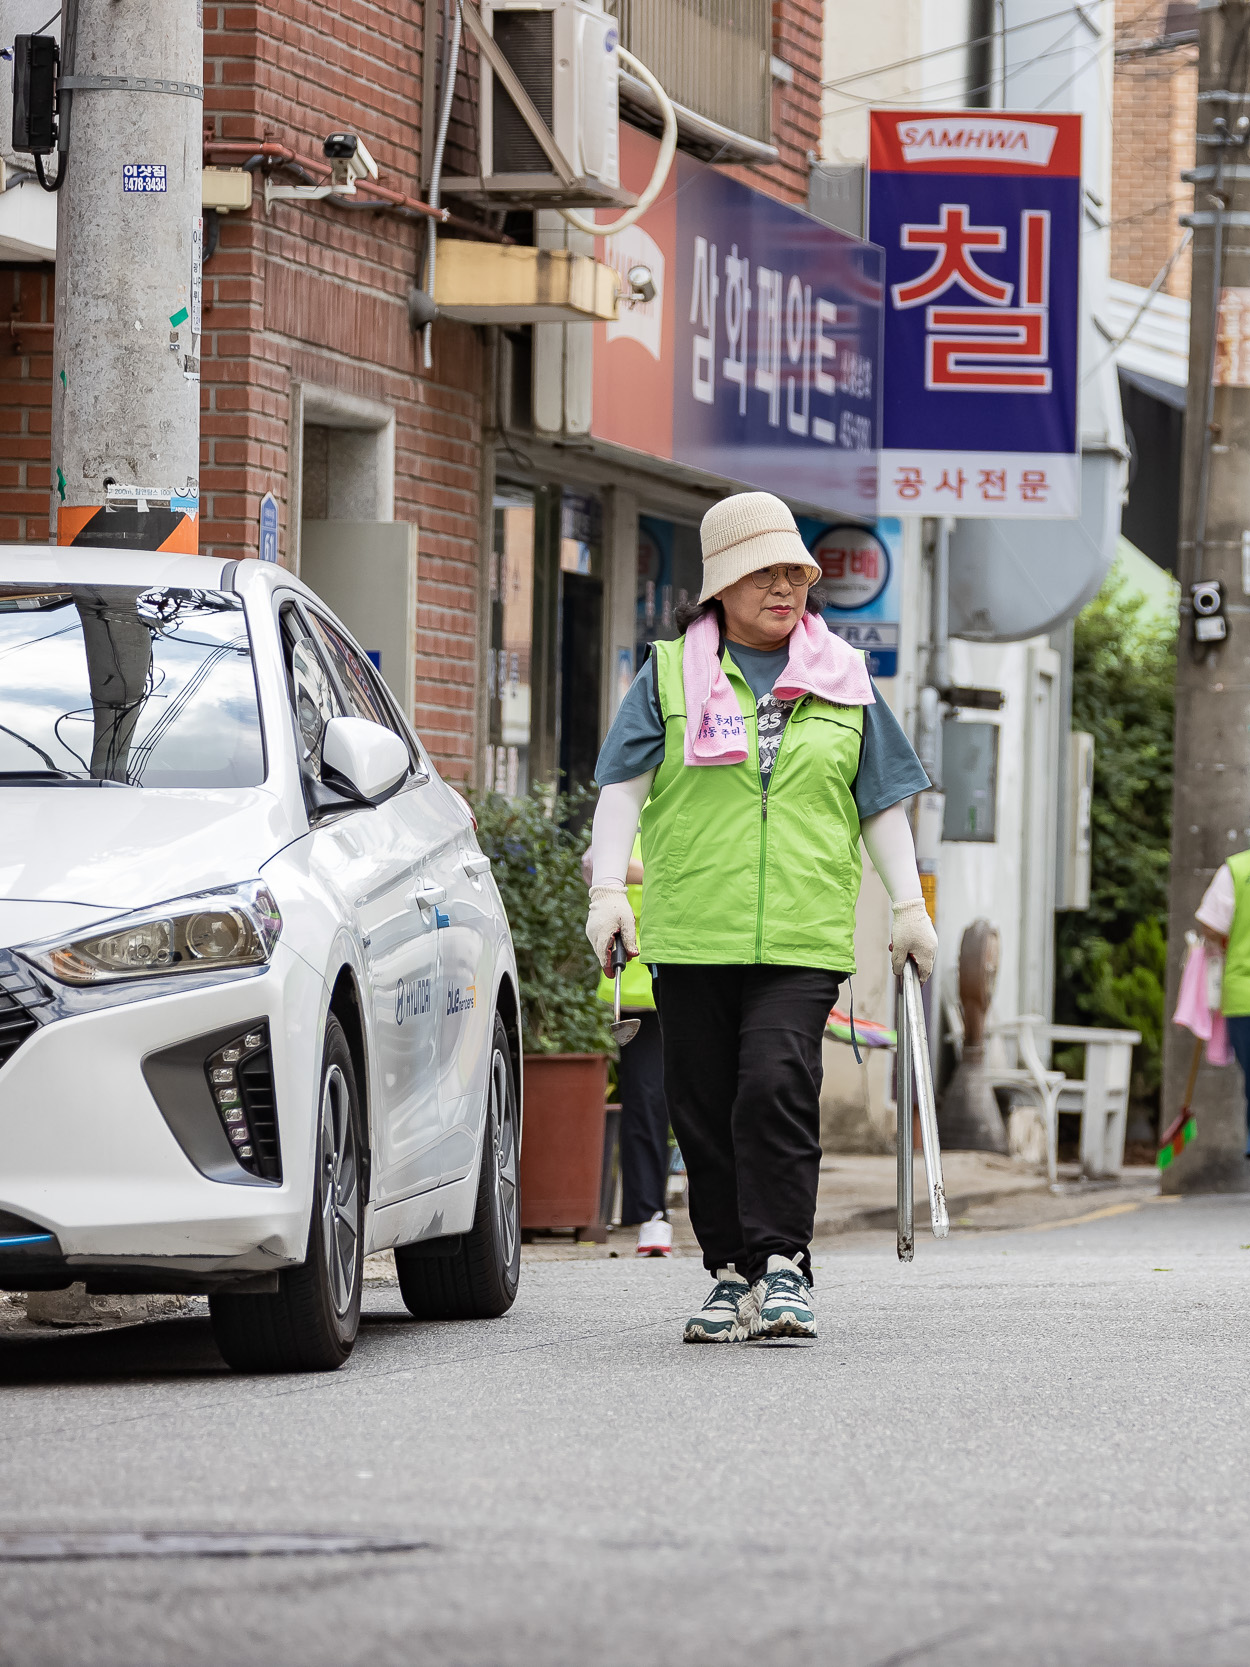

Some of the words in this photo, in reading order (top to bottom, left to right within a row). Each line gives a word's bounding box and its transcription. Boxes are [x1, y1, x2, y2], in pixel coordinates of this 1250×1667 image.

[901, 127, 1028, 151] SAMHWA
[124, 165, 165, 177] 이삿짐
[891, 203, 1053, 394] 칠
[689, 234, 837, 445] 삼화페인트
[893, 466, 1050, 502] 공사전문
[818, 548, 879, 579] 담배
